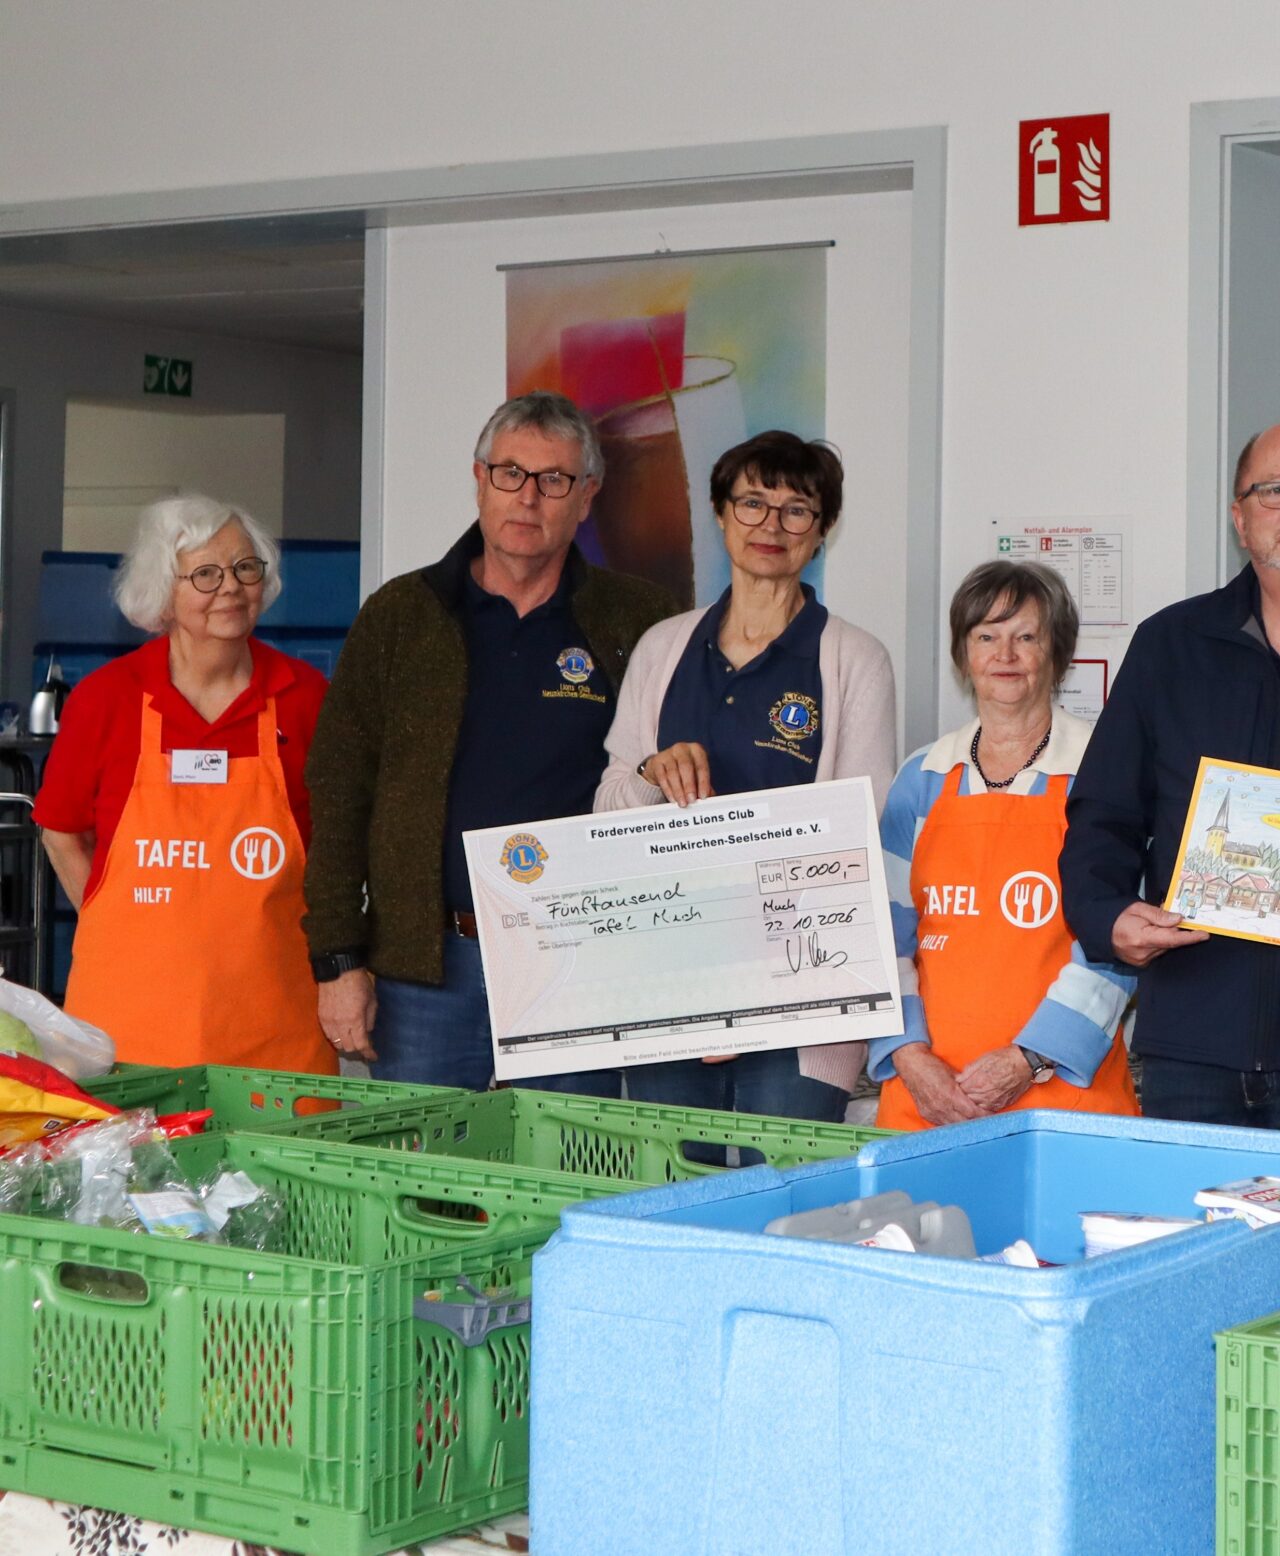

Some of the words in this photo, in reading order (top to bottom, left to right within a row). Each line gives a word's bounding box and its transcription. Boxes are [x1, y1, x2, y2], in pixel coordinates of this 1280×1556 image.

[785, 705, 800, 726] L
[668, 817, 690, 829] des
[692, 811, 725, 826] Lions
[728, 808, 755, 821] Club
[649, 826, 793, 855] Neunkirchen-Seelscheid
[796, 826, 807, 836] e.
[809, 823, 822, 834] V.
[135, 839, 211, 869] TAFEL
[518, 849, 534, 866] L
[761, 872, 783, 884] EUR
[134, 887, 172, 903] HILFT
[546, 882, 686, 920] Fünftausend
[501, 912, 531, 929] DE
[920, 934, 949, 951] HILFT
